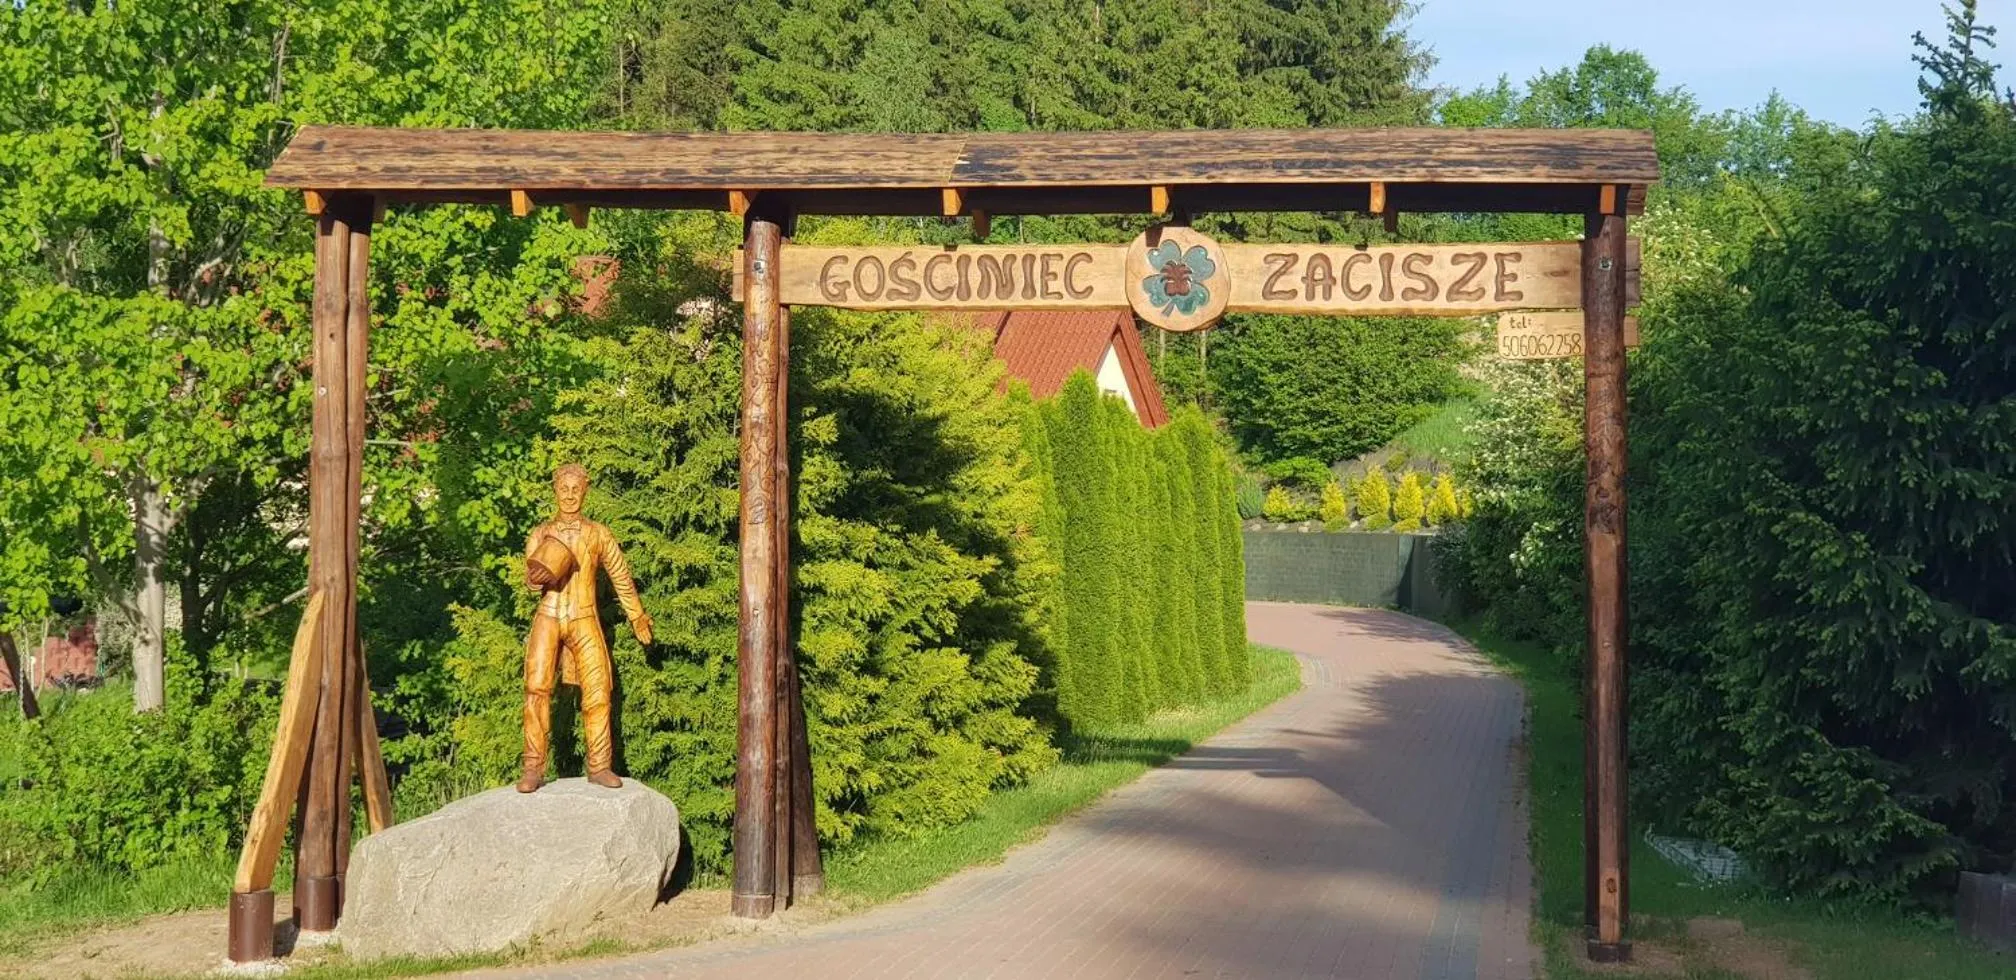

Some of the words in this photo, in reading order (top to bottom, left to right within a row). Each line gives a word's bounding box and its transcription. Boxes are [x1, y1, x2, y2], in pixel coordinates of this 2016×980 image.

[819, 251, 1094, 302] GOŚCINIEC
[1261, 252, 1524, 302] ZACISZE
[1502, 333, 1582, 357] 506062258
